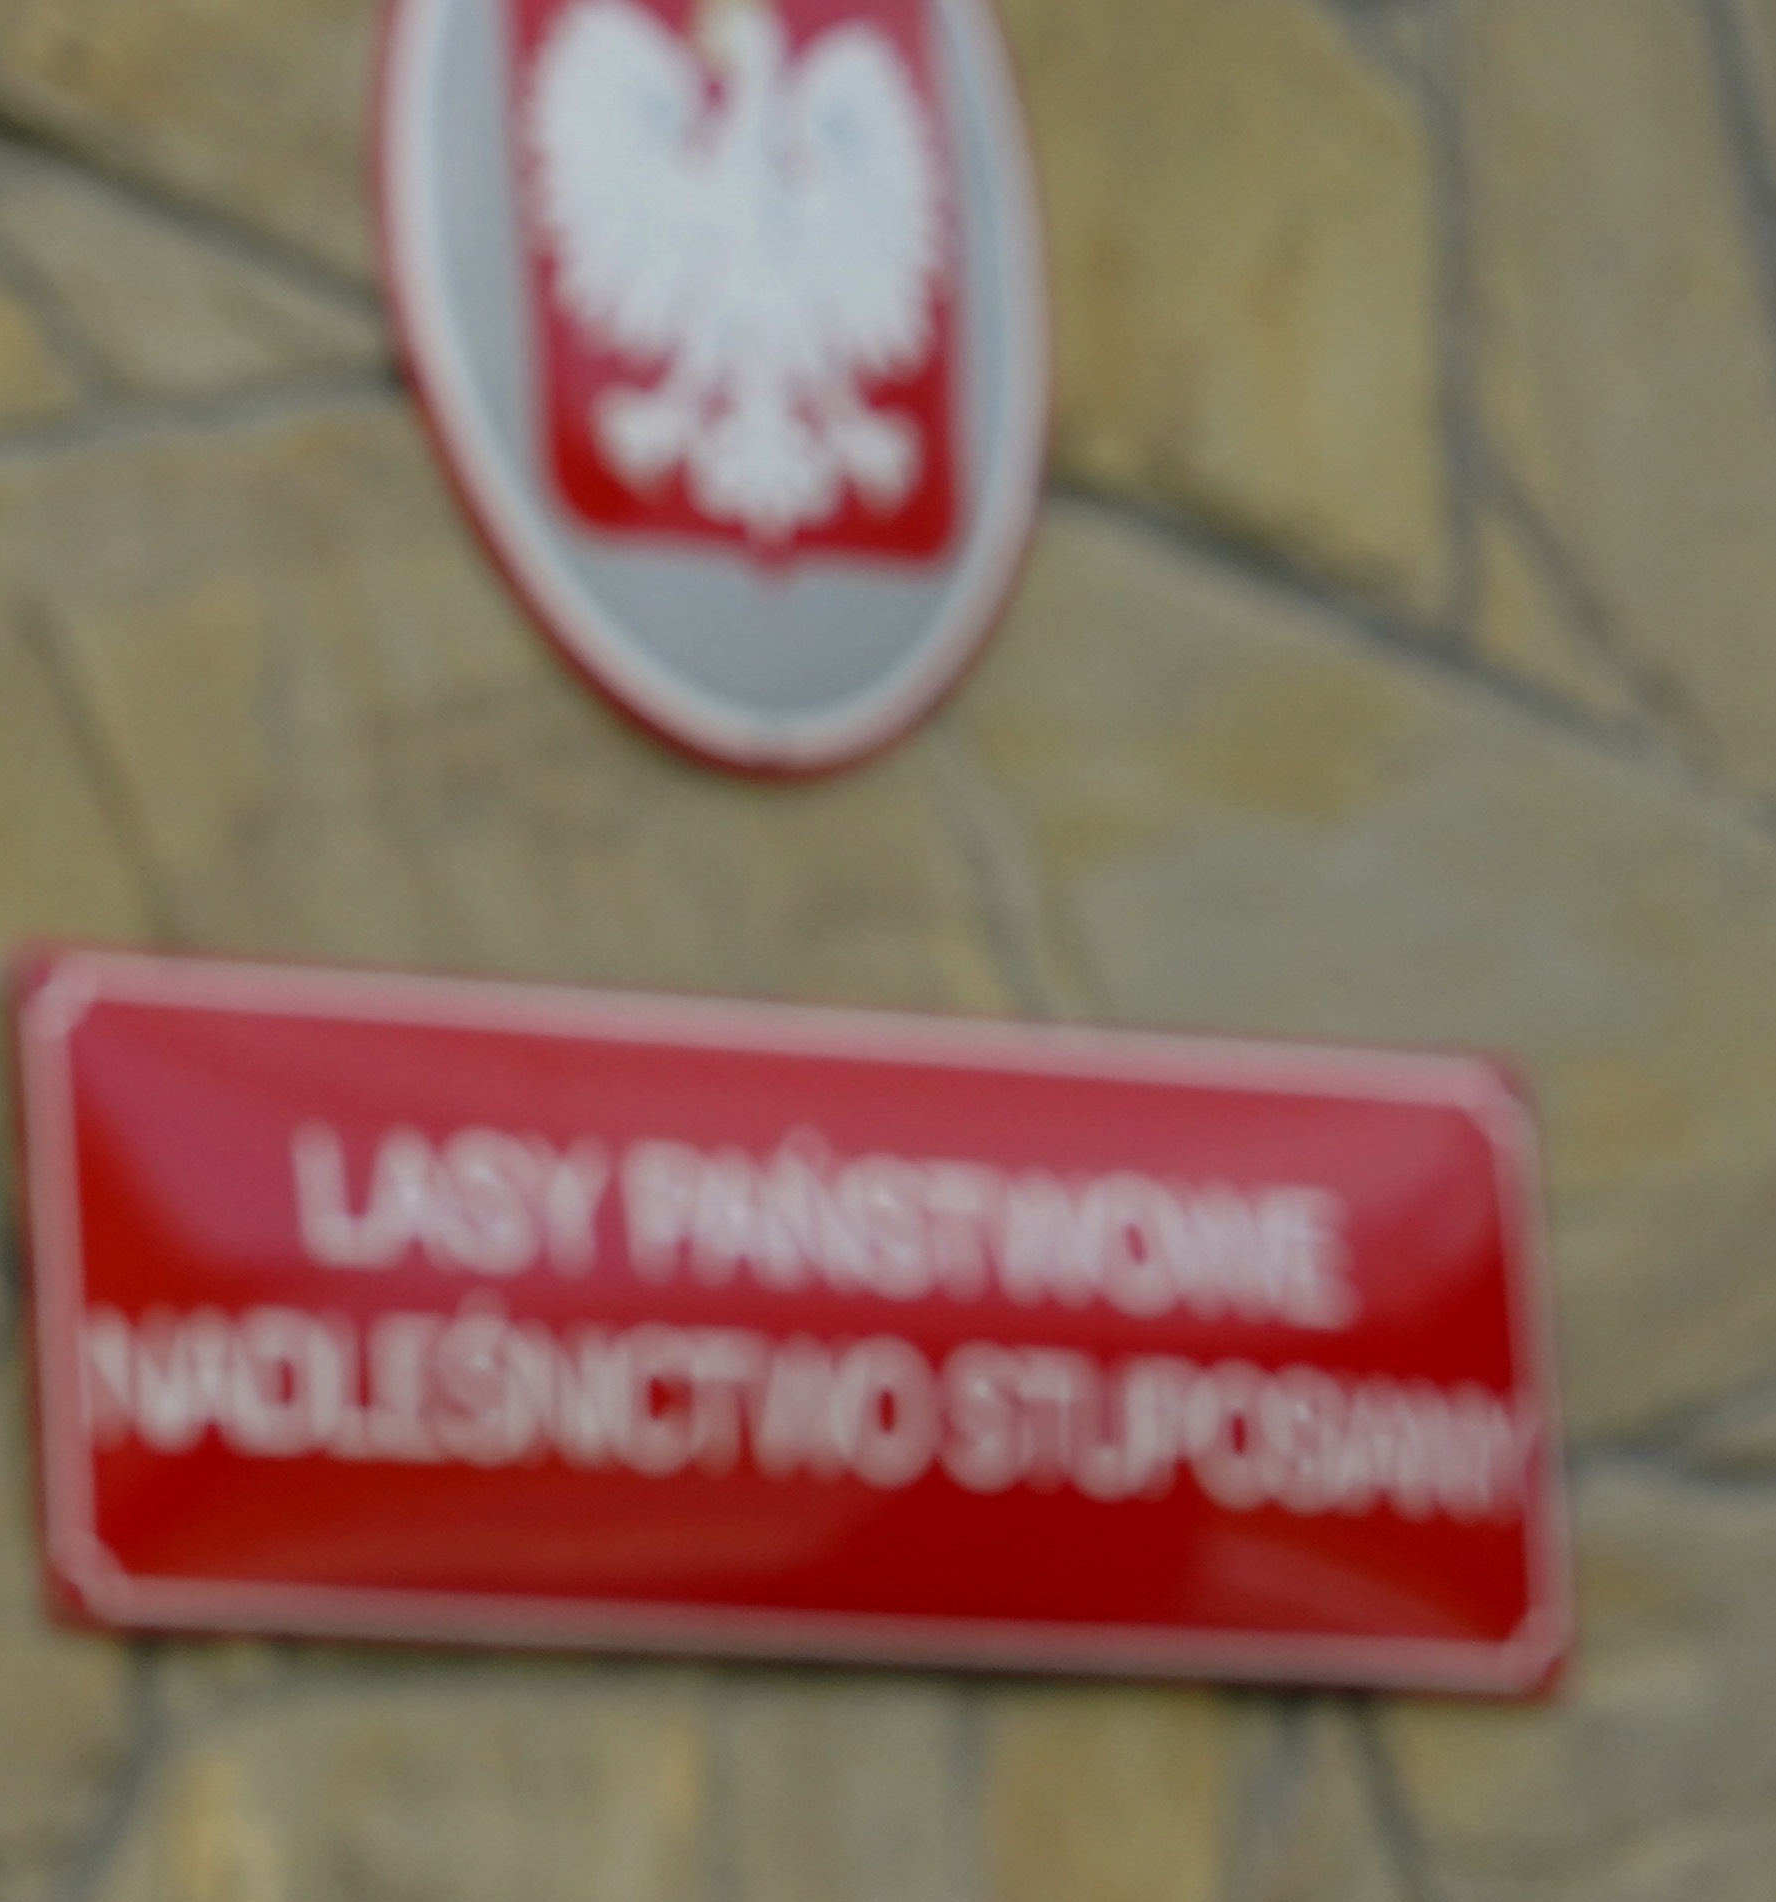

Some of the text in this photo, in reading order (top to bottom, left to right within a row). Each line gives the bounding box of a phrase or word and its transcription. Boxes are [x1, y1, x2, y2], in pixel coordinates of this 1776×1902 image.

[293, 1124, 1353, 1326] LASY PAŃSTWOWE
[87, 1298, 929, 1485] NADLEŚNICTWO
